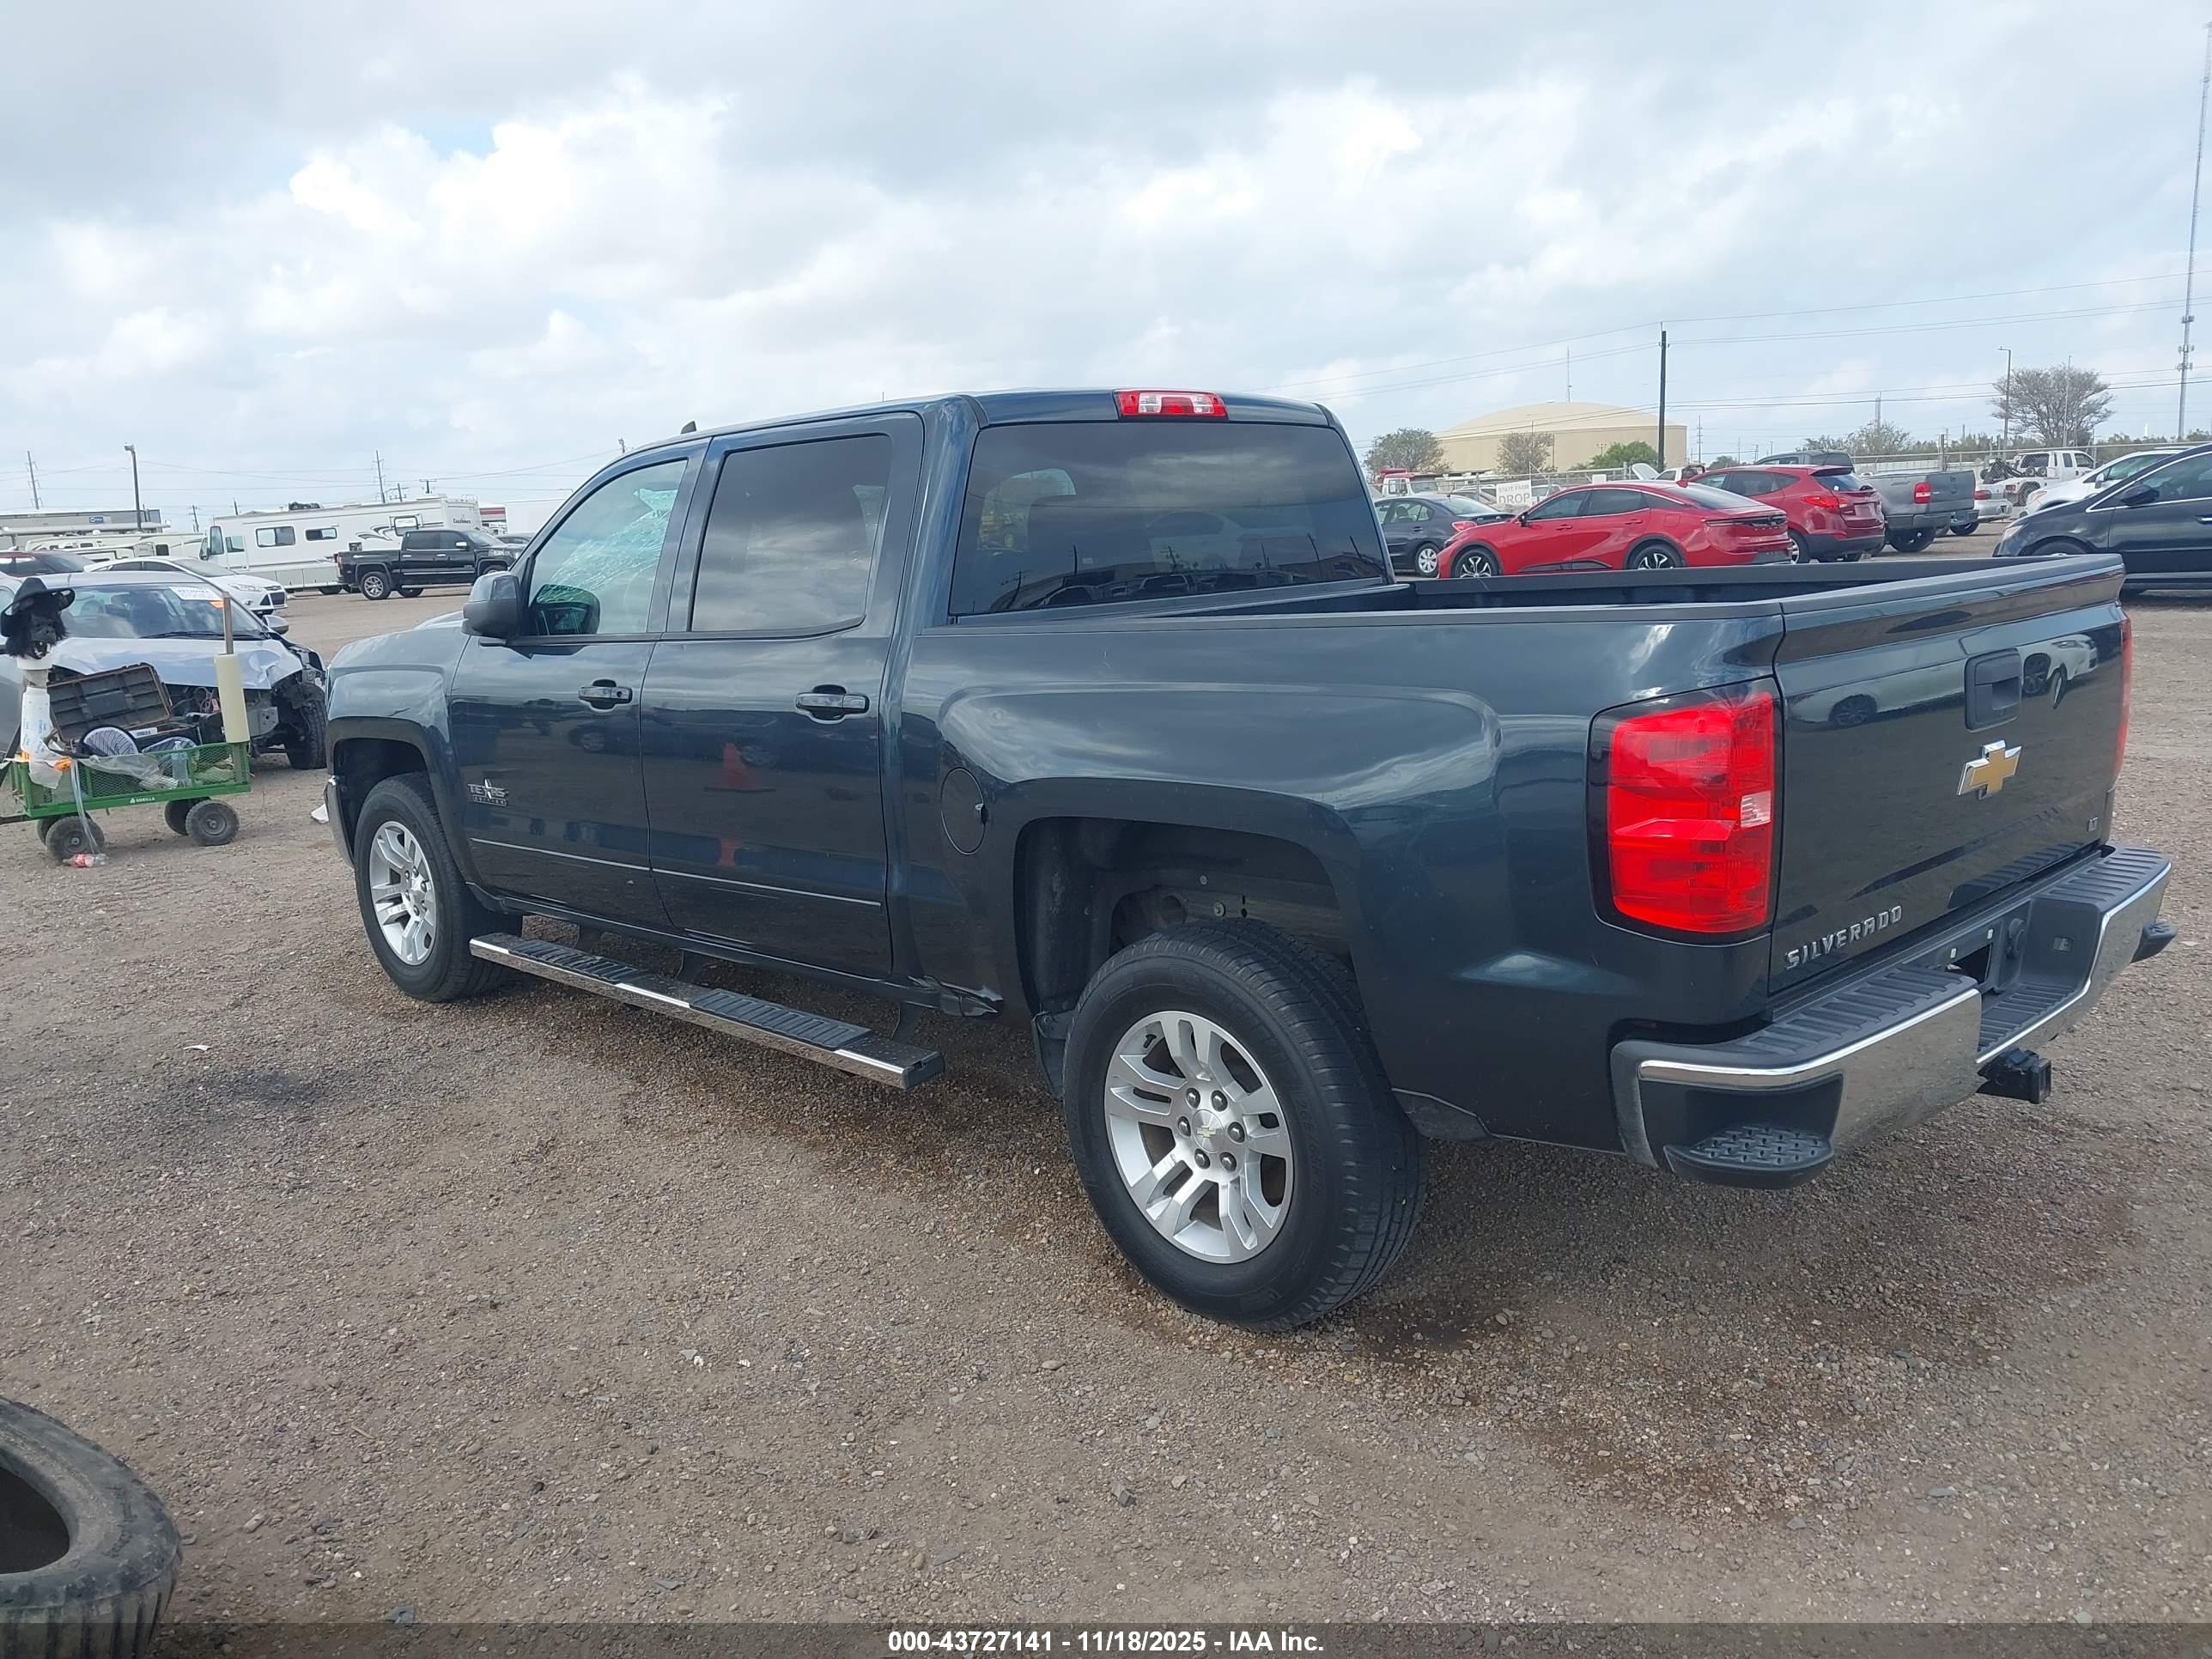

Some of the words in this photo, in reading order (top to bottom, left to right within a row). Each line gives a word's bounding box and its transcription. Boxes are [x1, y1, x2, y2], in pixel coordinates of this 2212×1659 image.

[1498, 493, 1529, 504] DROP
[467, 781, 507, 798] TEXAS
[1784, 905, 1903, 970] SILVERADO
